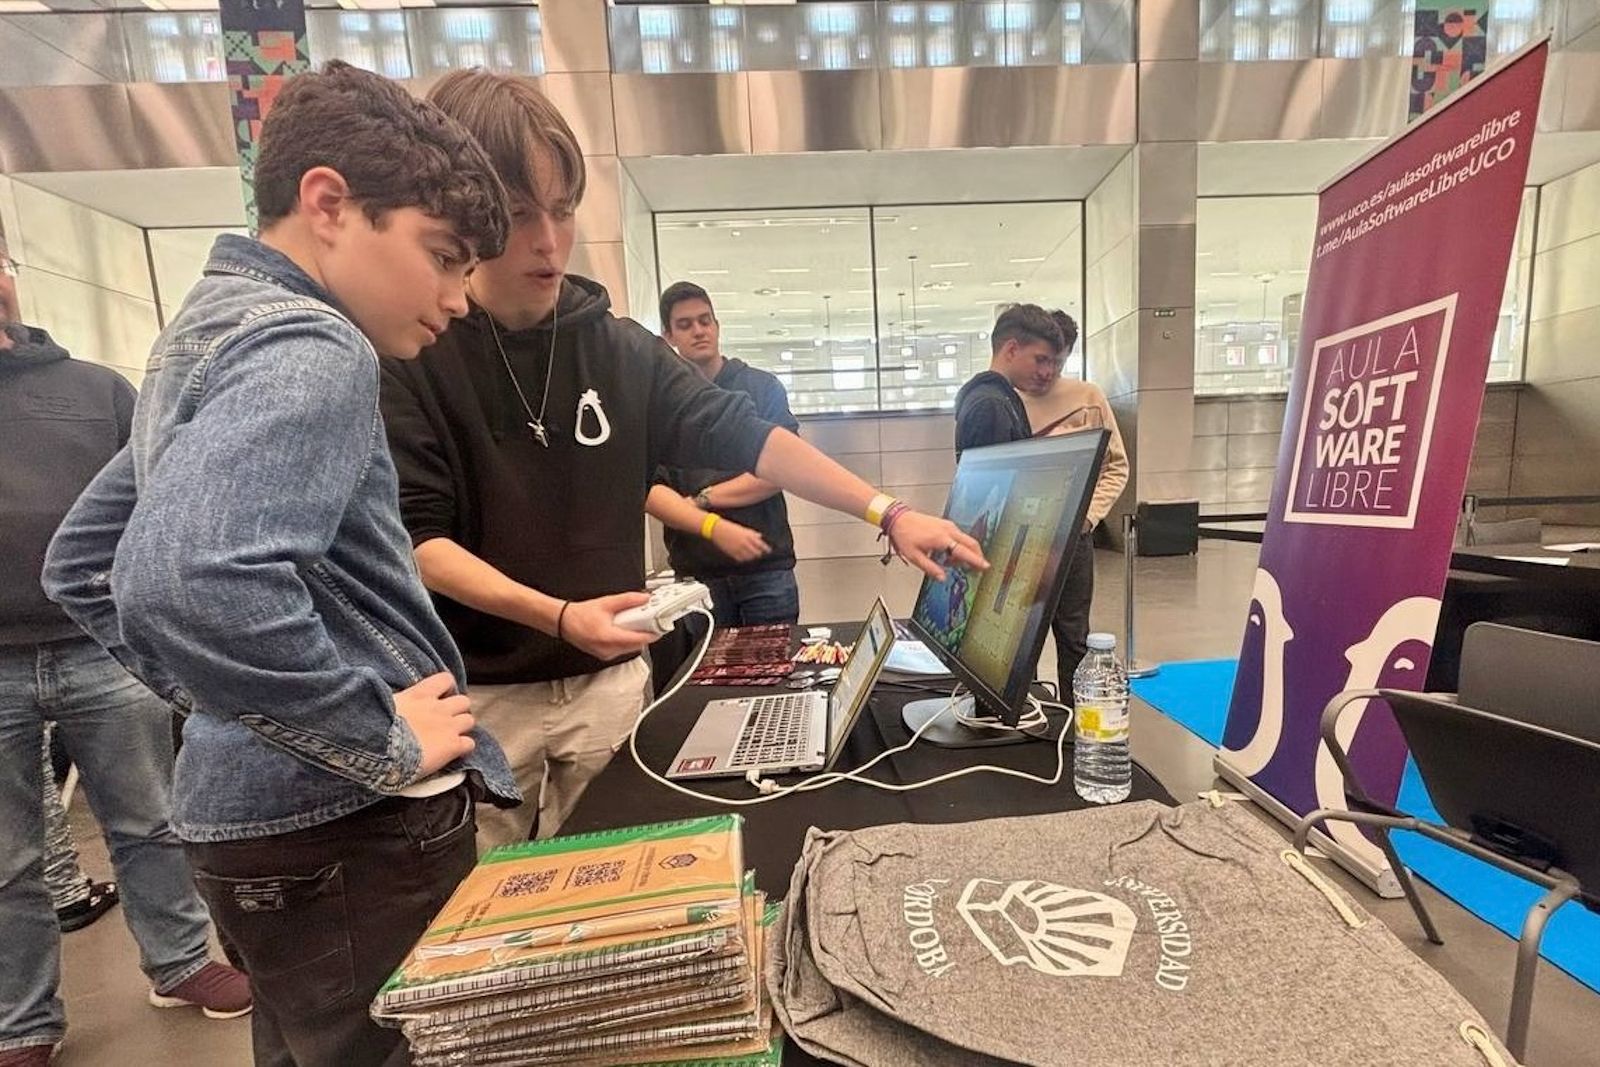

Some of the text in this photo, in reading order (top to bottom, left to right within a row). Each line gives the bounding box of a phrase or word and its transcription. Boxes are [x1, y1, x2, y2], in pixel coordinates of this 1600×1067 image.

[1315, 137, 1516, 259] t.me/AulaSoftwareLibreUCO
[1319, 109, 1521, 237] www.uco.es/aulasoftwarelibre
[1327, 326, 1420, 385] AULA
[1320, 371, 1418, 431] SOFT
[1316, 424, 1406, 468] WARE
[1306, 470, 1398, 509] LIBRE
